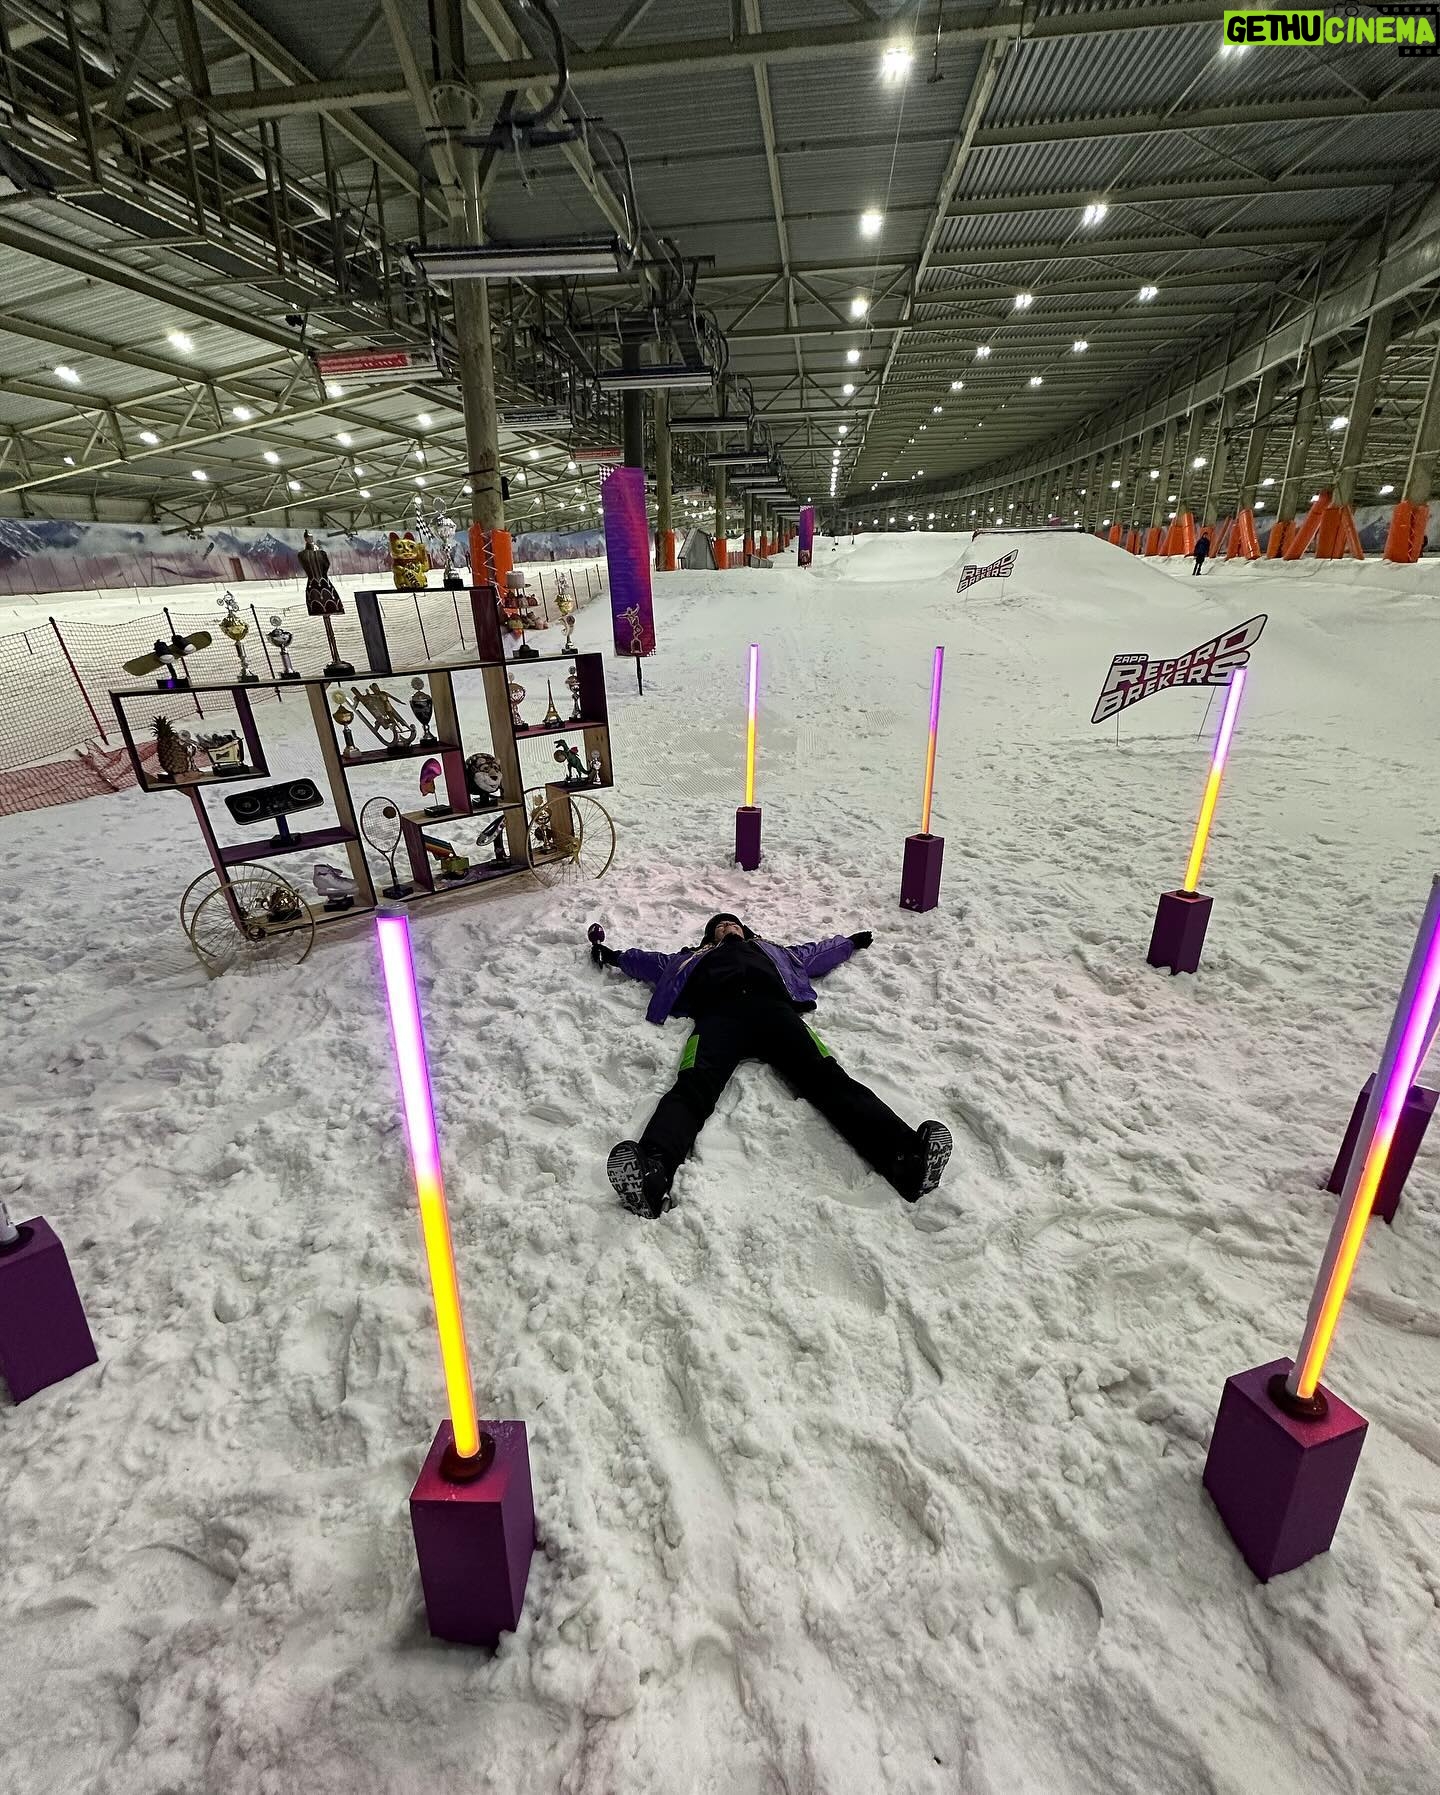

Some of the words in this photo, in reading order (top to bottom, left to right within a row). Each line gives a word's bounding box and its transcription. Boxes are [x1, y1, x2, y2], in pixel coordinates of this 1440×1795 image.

[961, 550, 1017, 581] RECORD
[1104, 615, 1267, 693] RECORD
[1114, 655, 1148, 664] ZAPP
[1093, 651, 1249, 723] BREKERS
